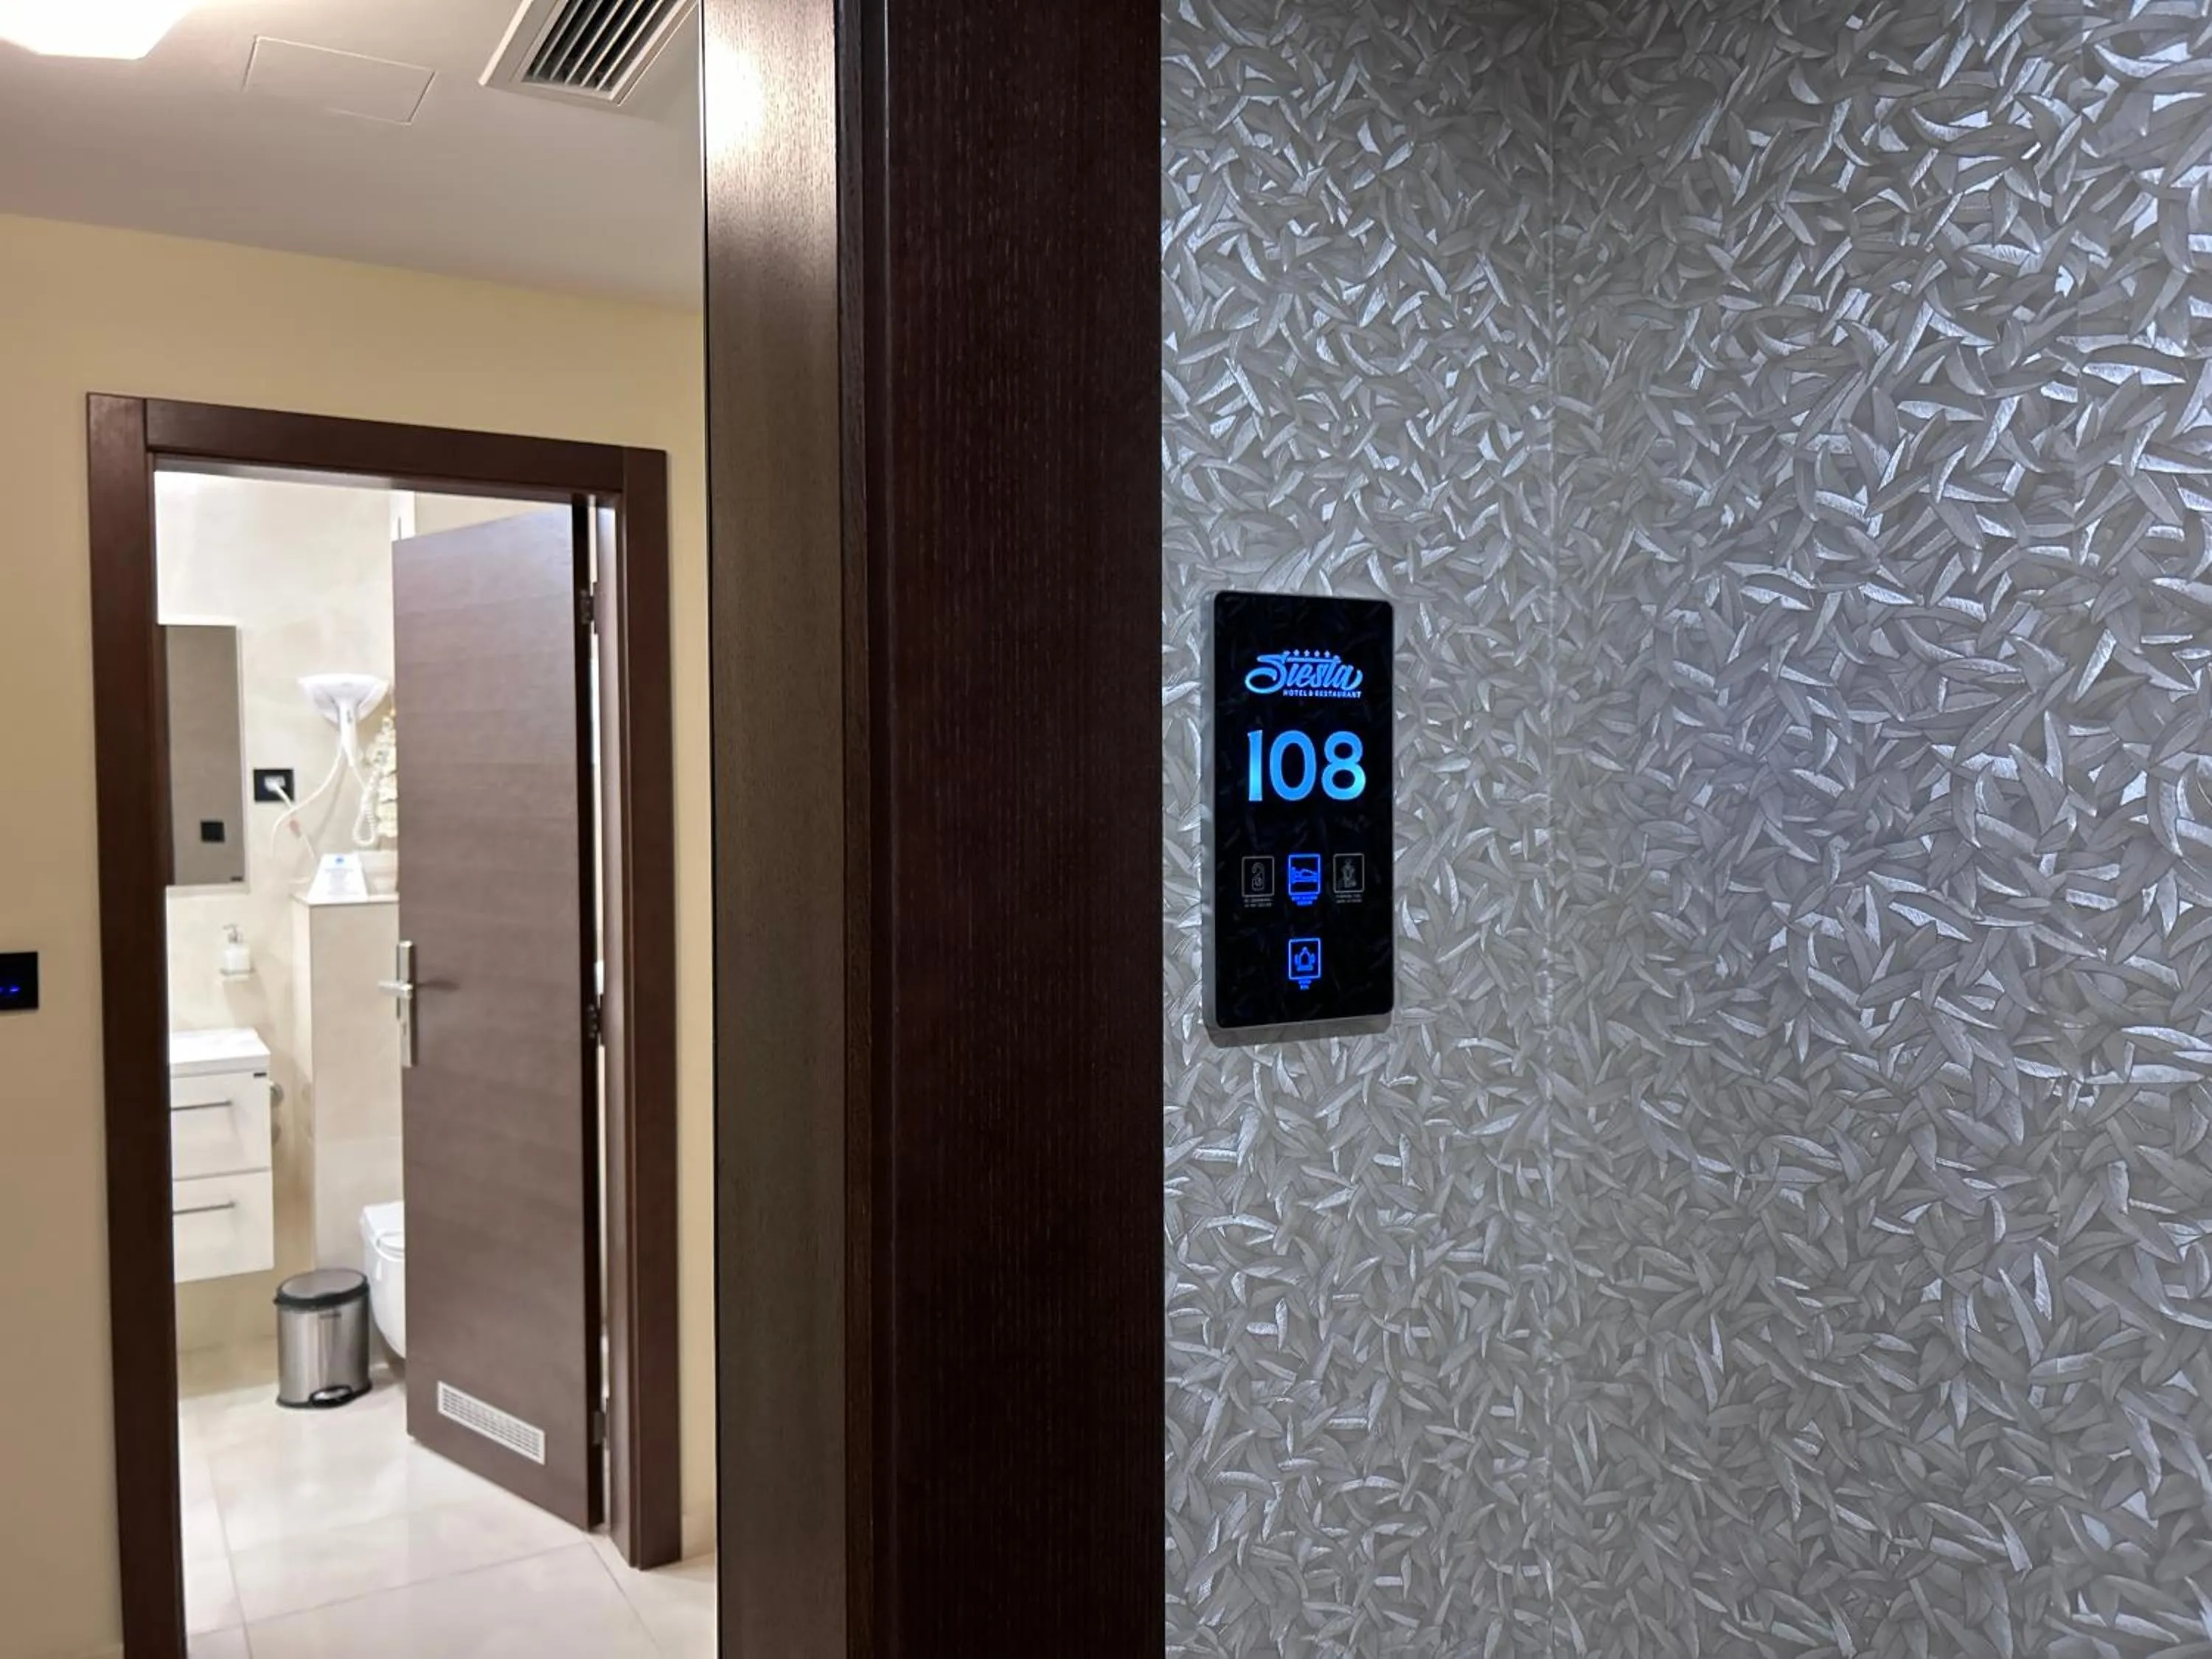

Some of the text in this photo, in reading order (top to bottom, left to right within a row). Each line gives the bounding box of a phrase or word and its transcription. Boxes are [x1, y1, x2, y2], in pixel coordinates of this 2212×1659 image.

[1245, 652, 1363, 694] Siesta
[1282, 689, 1307, 698] HOTEL
[1315, 690, 1362, 699] RESTAURANT
[1247, 729, 1366, 801] 108
